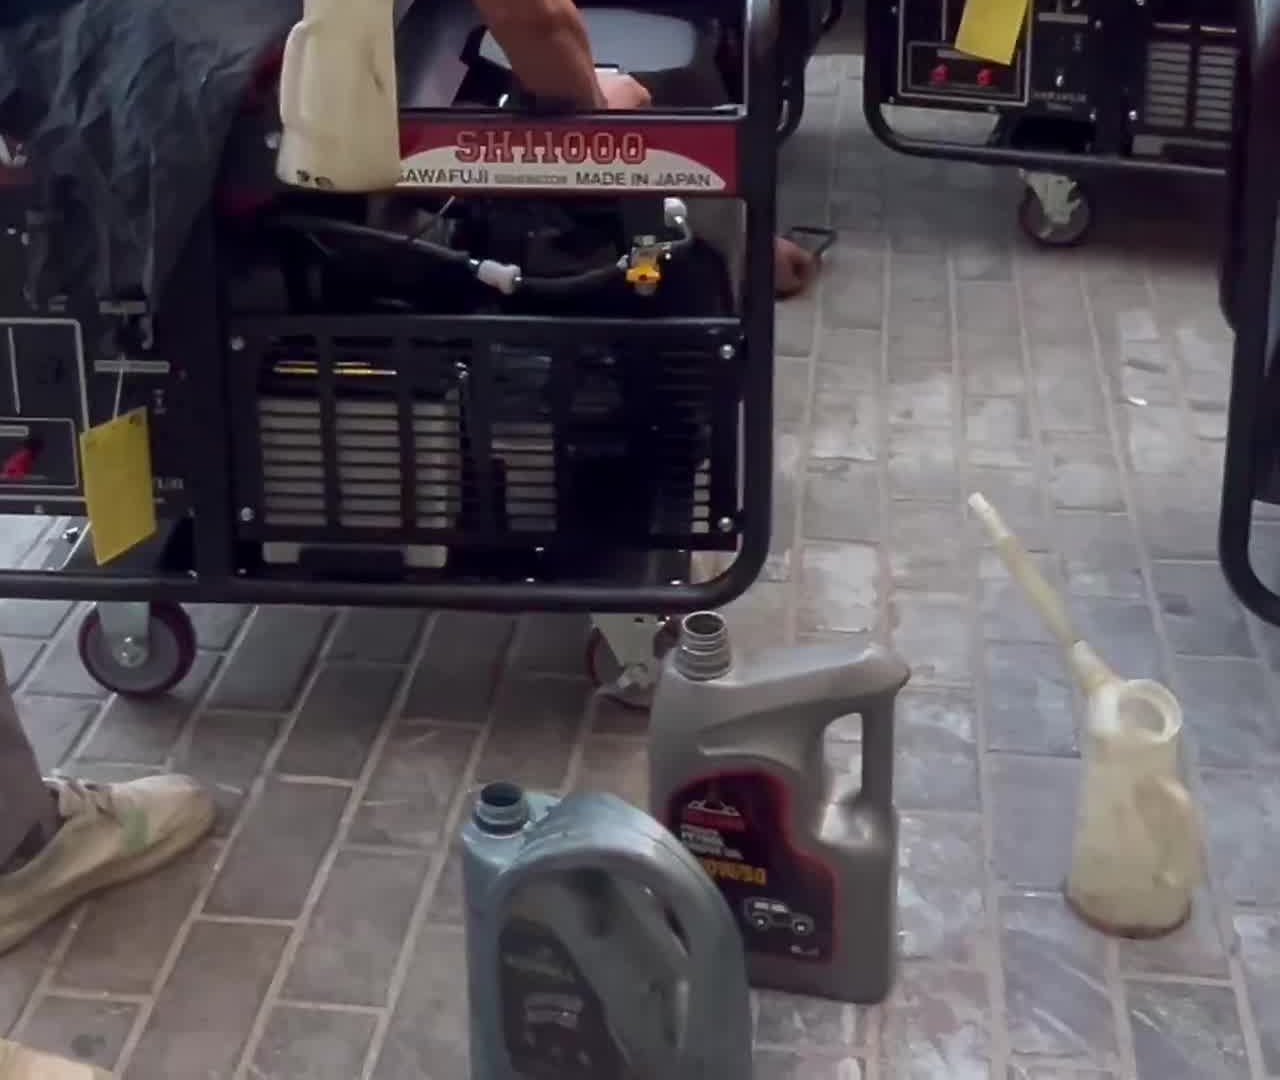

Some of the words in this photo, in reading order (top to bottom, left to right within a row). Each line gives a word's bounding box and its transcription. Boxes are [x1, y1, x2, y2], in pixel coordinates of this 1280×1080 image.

[454, 129, 647, 165] SH11000
[575, 171, 626, 186] MADE
[631, 172, 649, 185] IN
[655, 172, 711, 187] JAPAN
